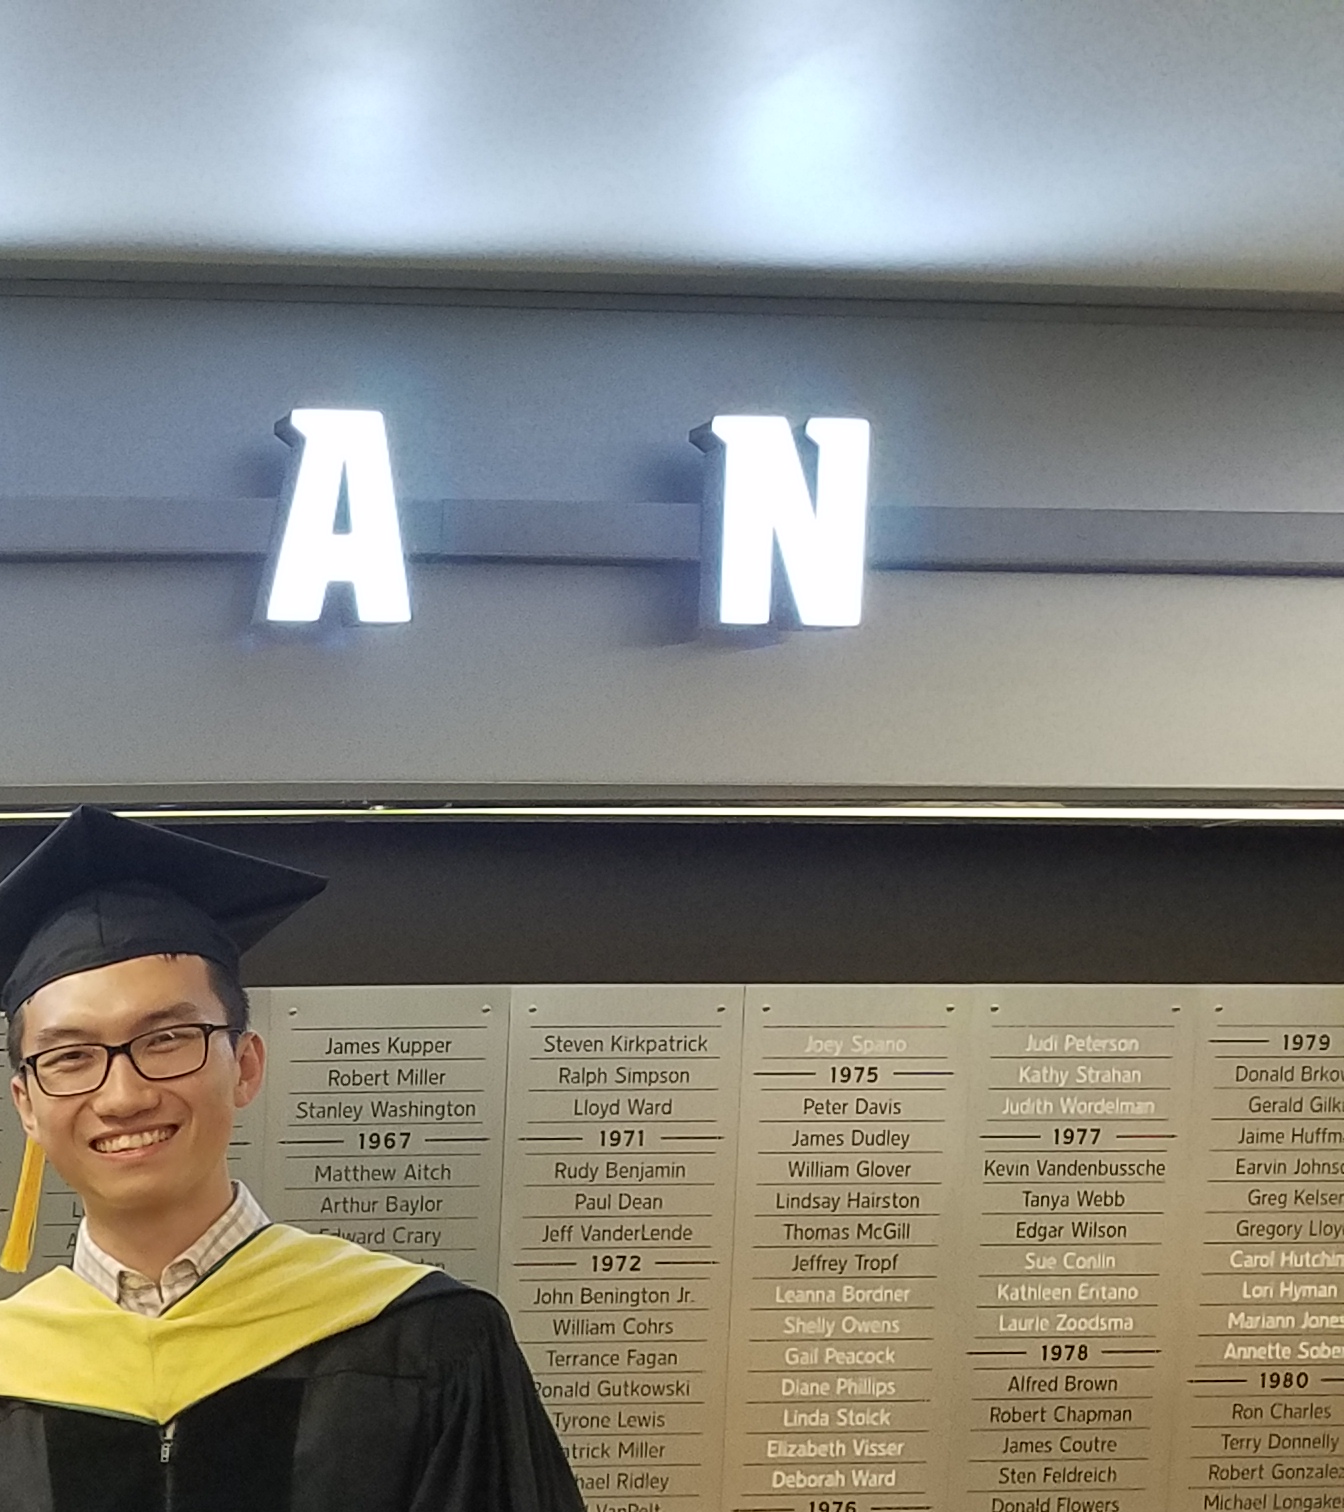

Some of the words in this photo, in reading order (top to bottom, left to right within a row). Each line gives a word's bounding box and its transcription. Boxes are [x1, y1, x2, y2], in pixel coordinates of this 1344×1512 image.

[324, 1037, 381, 1056] James
[387, 1036, 453, 1057] Kupper
[543, 1034, 604, 1053] Steven
[610, 1034, 708, 1055] Kirkpatrick
[1283, 1033, 1331, 1052] 1979
[328, 1068, 390, 1087] Robert
[396, 1068, 446, 1086] Miller
[558, 1066, 608, 1088] Ralph
[614, 1066, 690, 1087] Simpson
[831, 1066, 879, 1084] 1975
[295, 1101, 364, 1123] Stanley
[370, 1100, 476, 1121] Washington
[573, 1098, 621, 1120] Lloyd
[627, 1098, 673, 1116] Ward
[803, 1097, 849, 1116] Peter
[855, 1097, 902, 1115] Davis
[358, 1131, 411, 1150] 1967
[600, 1129, 644, 1148] 1971
[791, 1129, 845, 1147] James
[851, 1128, 911, 1151] Dudley
[1054, 1127, 1101, 1146] 1977
[314, 1164, 397, 1183] Matthew
[403, 1163, 452, 1181] Aitch
[554, 1161, 600, 1183] Rudy
[605, 1161, 686, 1183] Benjamin
[320, 1196, 379, 1214] Arthur
[385, 1194, 444, 1217] Baylor
[574, 1192, 612, 1211] Paul
[618, 1192, 663, 1211] Dean
[1022, 1190, 1070, 1212] Tanya
[1076, 1189, 1126, 1208] Webb
[782, 1223, 850, 1241] Thomas
[856, 1221, 911, 1241] McGill
[1015, 1221, 1065, 1243] Edgar
[1071, 1221, 1127, 1239] Wilson
[592, 1254, 642, 1273] 1972
[552, 1318, 616, 1337] William
[622, 1316, 674, 1336] Cohrs
[1041, 1343, 1089, 1362] 1978
[1260, 1371, 1309, 1389] 1980
[989, 1406, 1047, 1424] Robert
[1053, 1405, 1133, 1425] Chapman
[1231, 1402, 1264, 1420] Ron
[1269, 1402, 1332, 1420] Charles
[1001, 1436, 1053, 1455] James
[1059, 1435, 1118, 1454] Coutre
[1220, 1433, 1262, 1454] Terry
[1267, 1432, 1340, 1453] Donnelly
